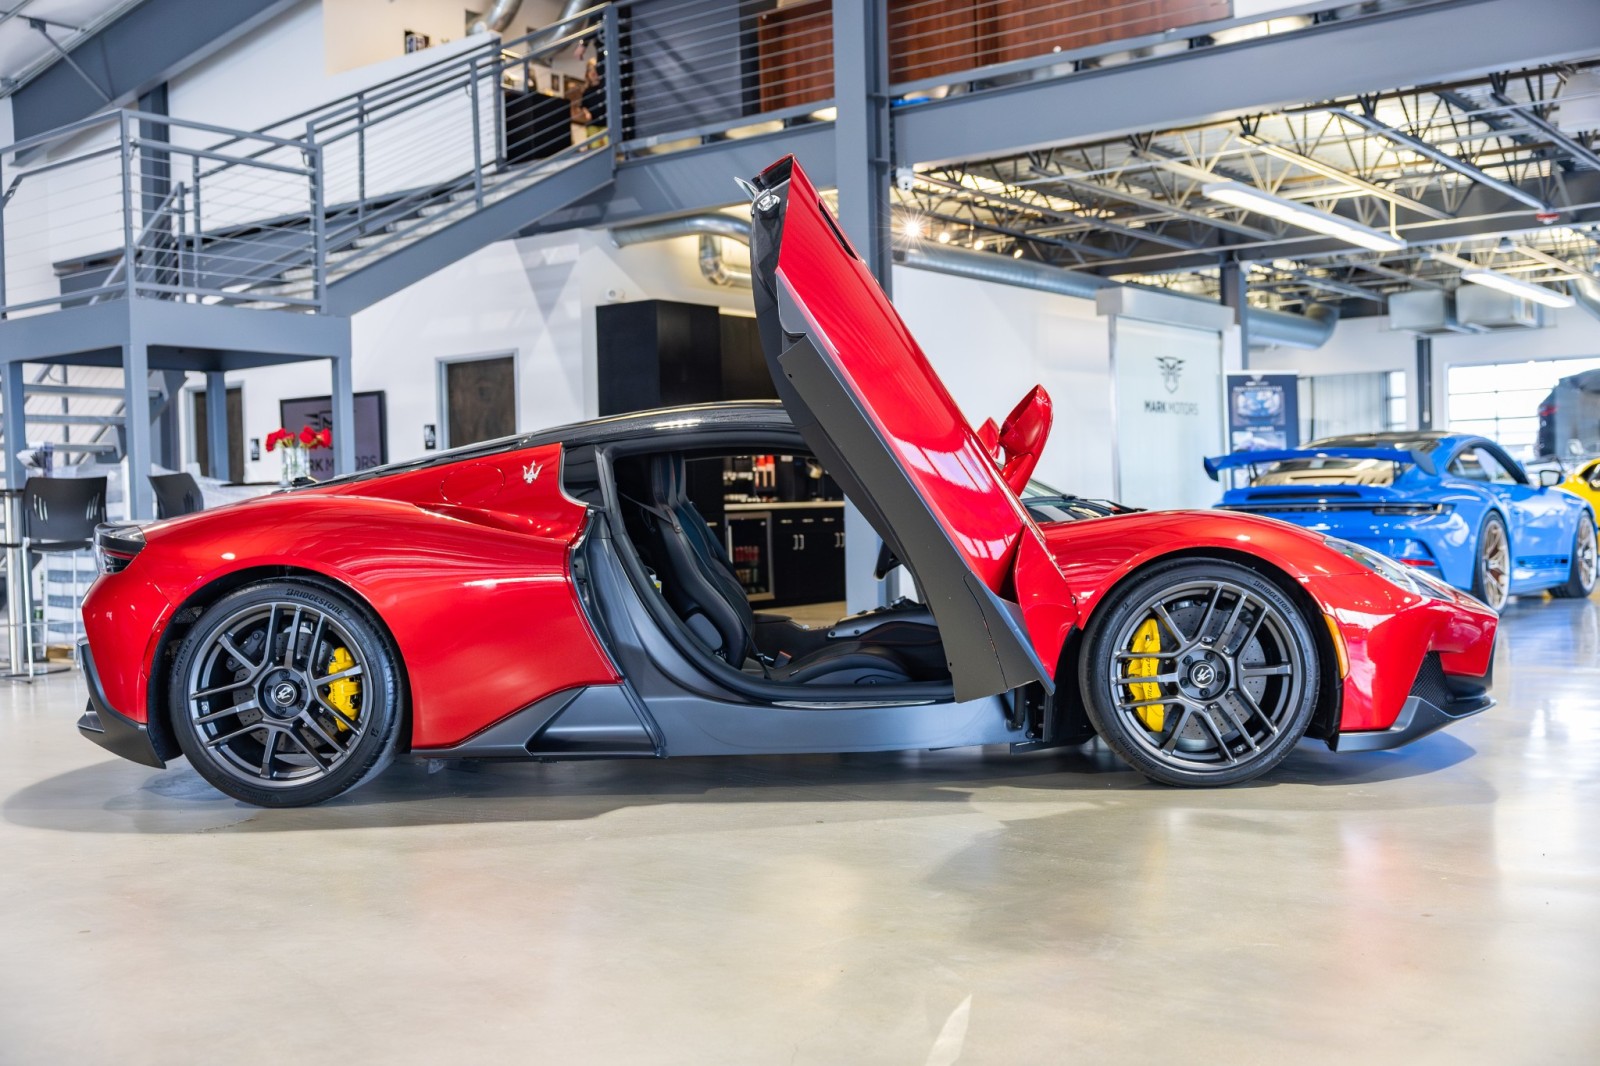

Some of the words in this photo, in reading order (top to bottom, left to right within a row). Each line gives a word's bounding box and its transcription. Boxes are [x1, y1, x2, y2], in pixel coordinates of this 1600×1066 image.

[1144, 400, 1166, 413] MARK
[1168, 402, 1199, 416] MOTORS
[286, 588, 345, 616] BRIDGESTONE
[1253, 580, 1295, 615] BRIDGESTONE
